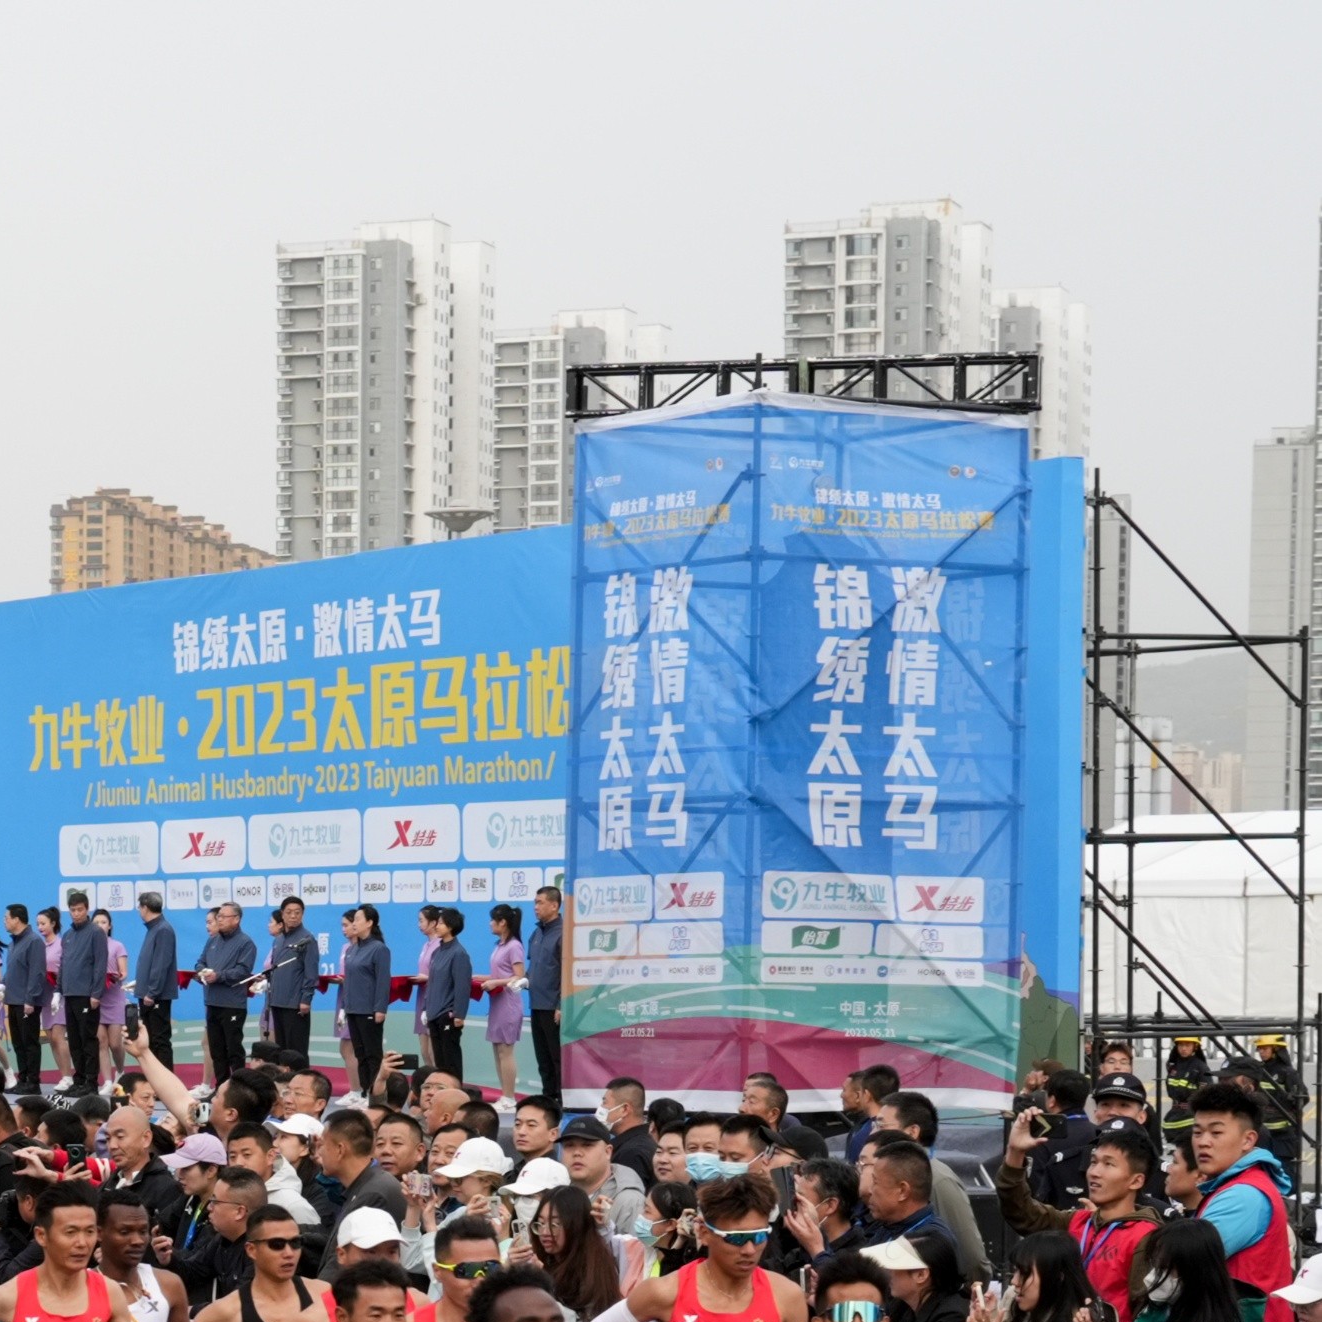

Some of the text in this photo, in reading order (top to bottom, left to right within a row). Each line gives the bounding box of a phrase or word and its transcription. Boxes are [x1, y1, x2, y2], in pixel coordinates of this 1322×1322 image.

[598, 573, 638, 851] 锦绣太原
[645, 566, 693, 847] 激情太马
[807, 563, 873, 848] 锦绣太原
[881, 566, 947, 849] 激情太马
[145, 774, 205, 805] Animal
[364, 760, 438, 797] Taiyuan
[289, 823, 341, 846] 九牛牧业
[236, 886, 262, 896] HONOR
[595, 884, 647, 906] 九牛牧业
[802, 881, 887, 904] 九牛牧业
[668, 967, 690, 975] HONOR
[620, 1027, 655, 1038] 2023.05.21
[844, 1026, 896, 1038] 2023.05.21
